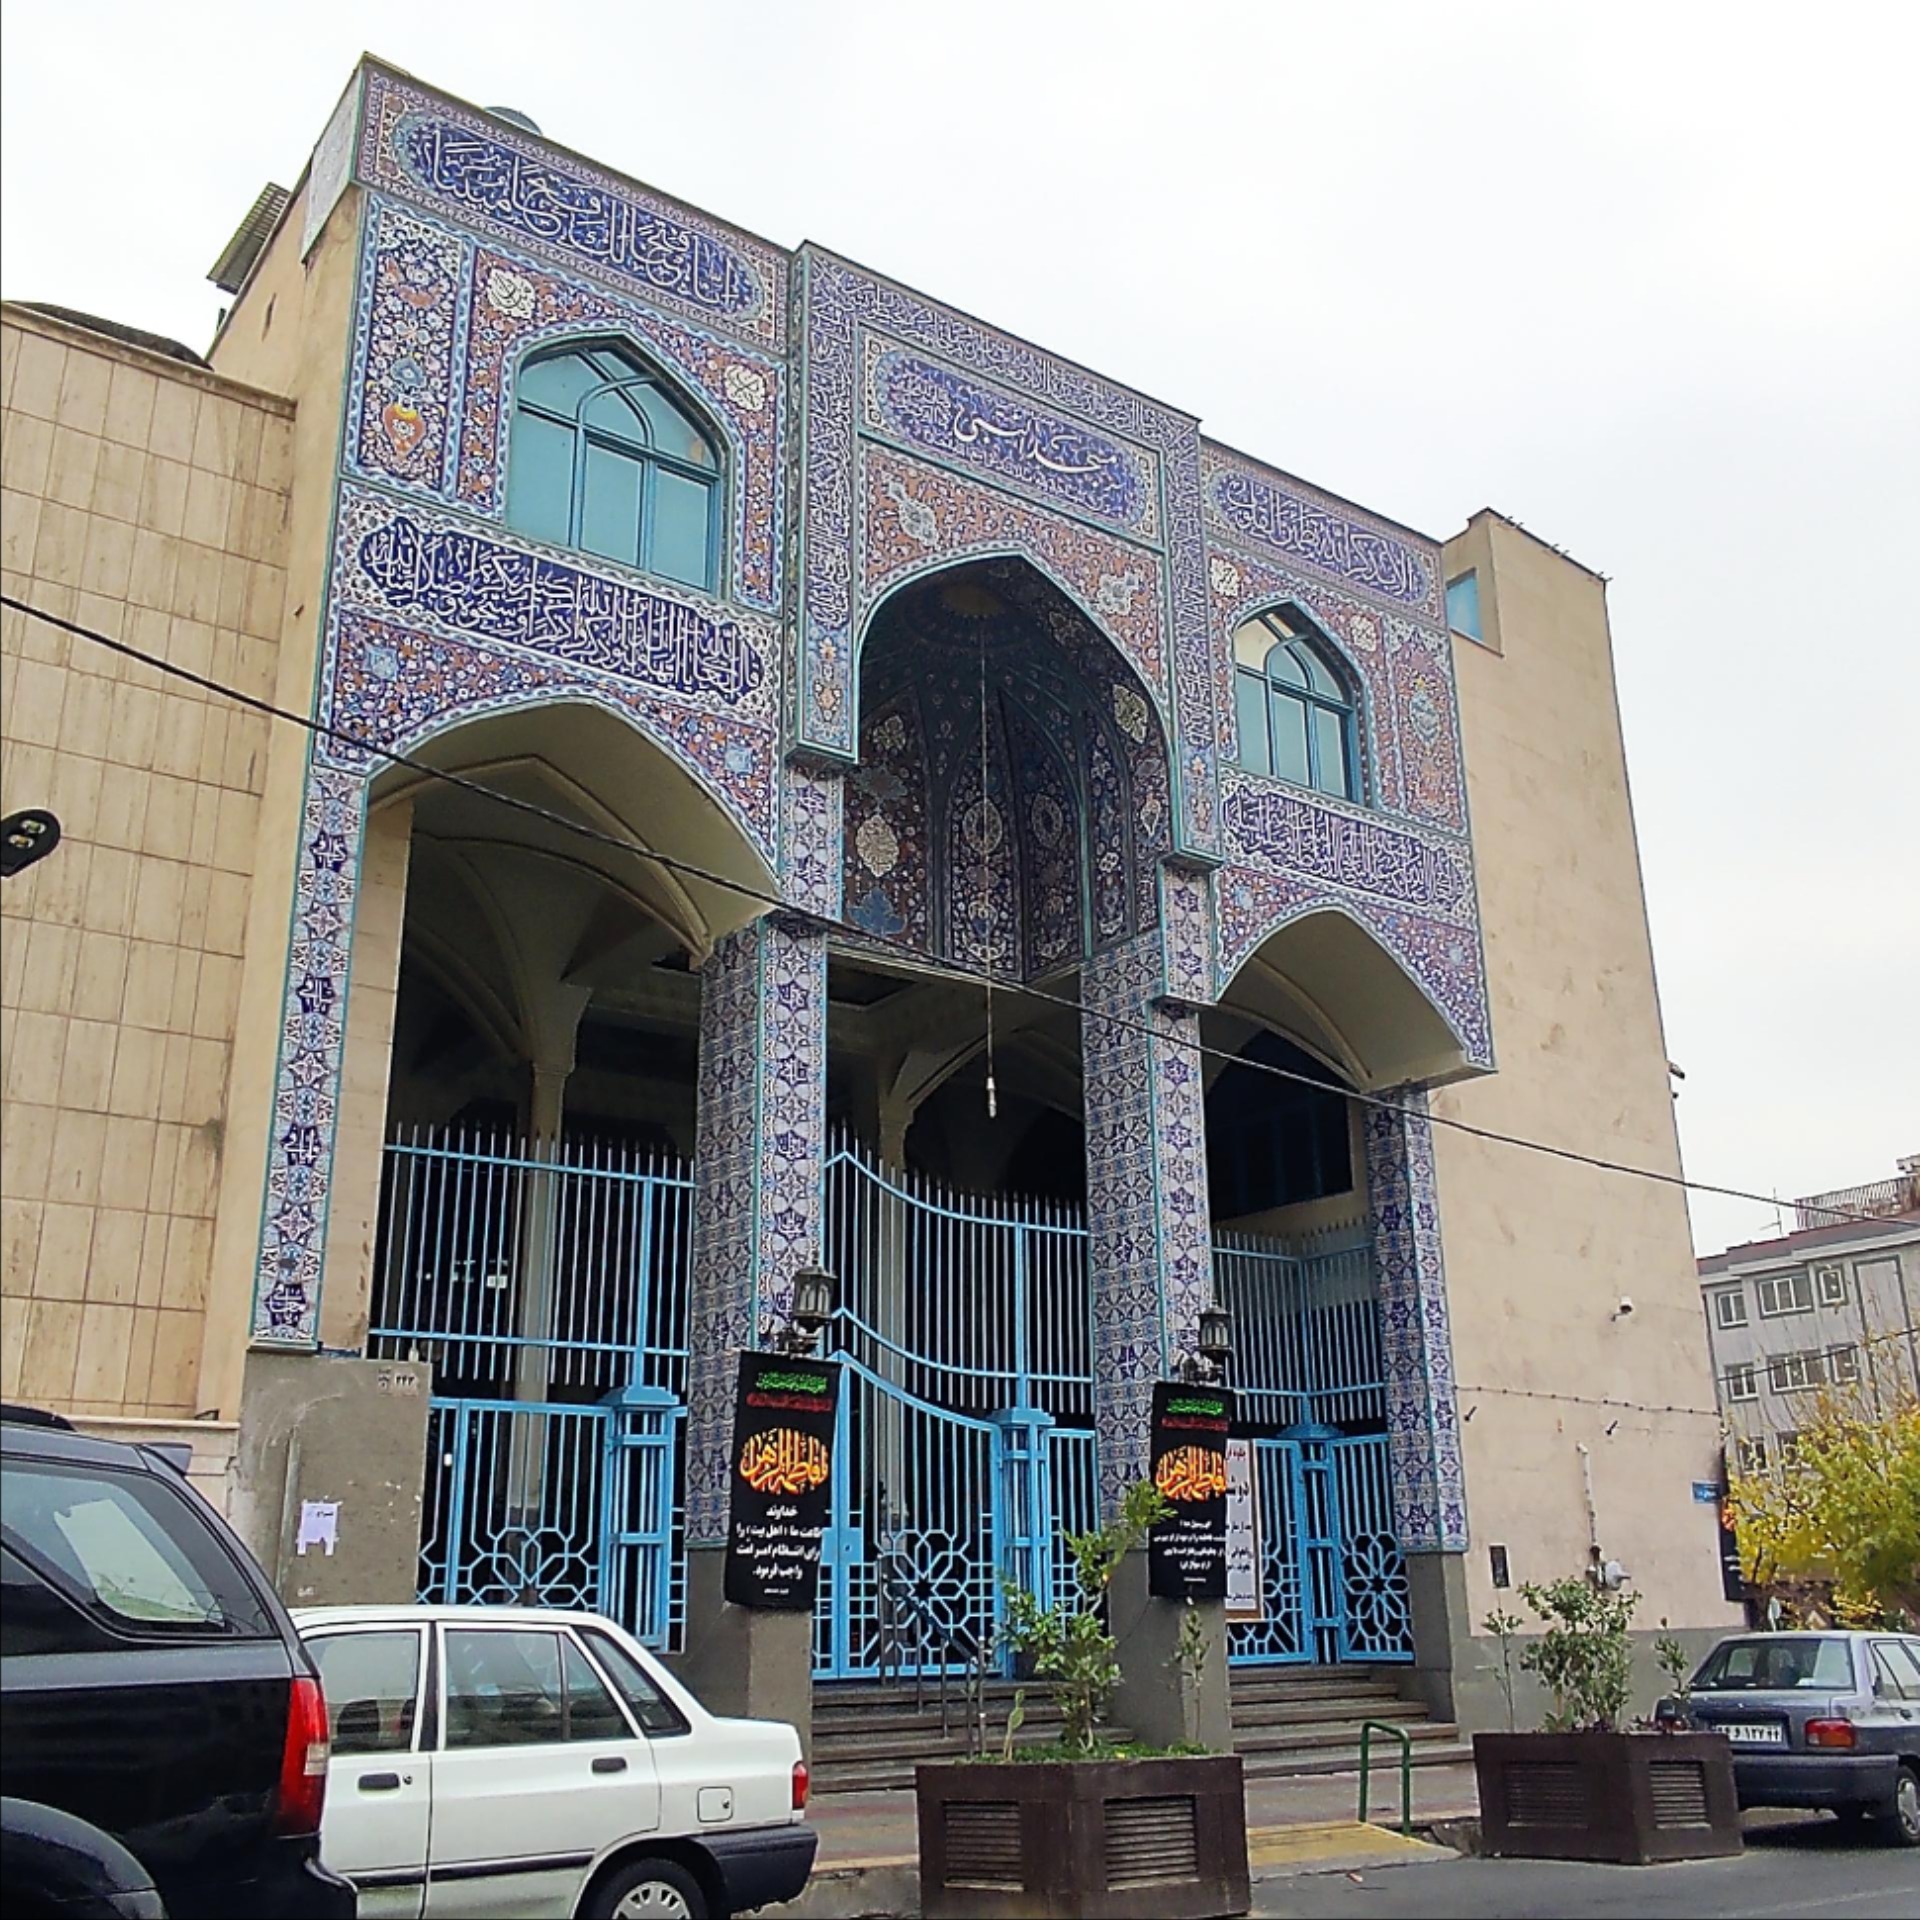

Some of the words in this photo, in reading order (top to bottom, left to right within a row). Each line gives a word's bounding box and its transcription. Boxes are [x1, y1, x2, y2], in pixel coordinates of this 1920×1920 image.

[765, 1504, 798, 1520] خداوند
[736, 1522, 746, 1538] را
[803, 1546, 821, 1561] رای
